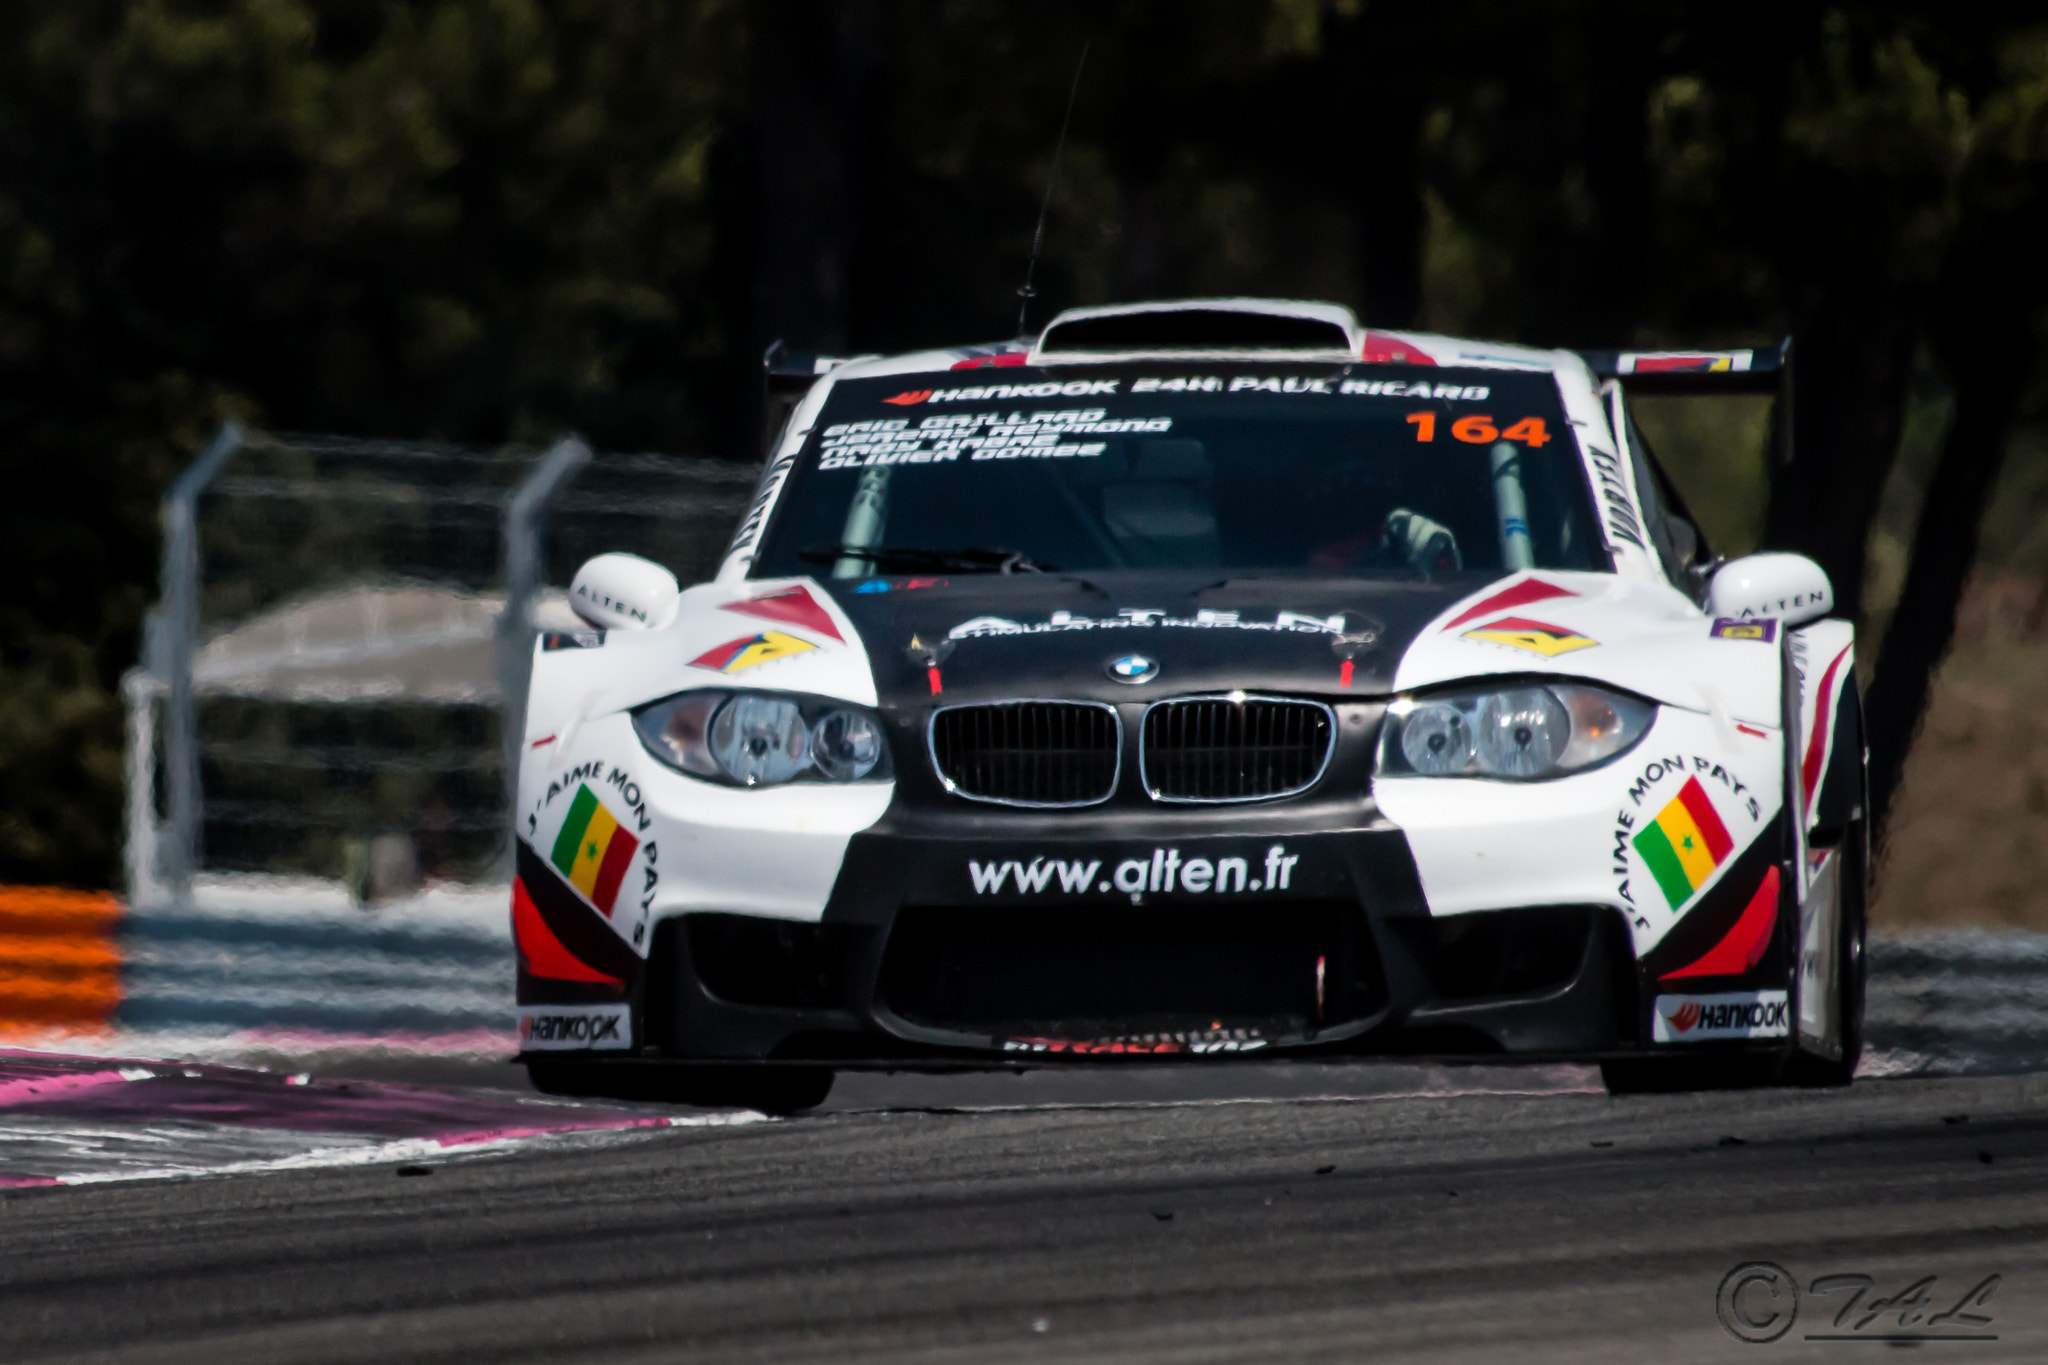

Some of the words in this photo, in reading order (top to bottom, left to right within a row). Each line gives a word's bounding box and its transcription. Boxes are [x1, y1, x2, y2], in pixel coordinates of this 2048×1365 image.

[1229, 376, 1332, 394] PAUL
[1339, 380, 1491, 400] RICARD
[1406, 411, 1552, 448] 164
[818, 450, 960, 471] OLIVIER
[577, 584, 647, 624] ALTEN
[1741, 590, 1824, 618] ALTEN
[1628, 755, 1685, 807] MON
[1693, 755, 1762, 823] PAYS
[528, 760, 604, 836] J'AIME
[606, 766, 652, 832] MON
[633, 841, 659, 947] PAYS
[969, 844, 1299, 895] www.alten.fr
[1612, 808, 1650, 929] J'AIME
